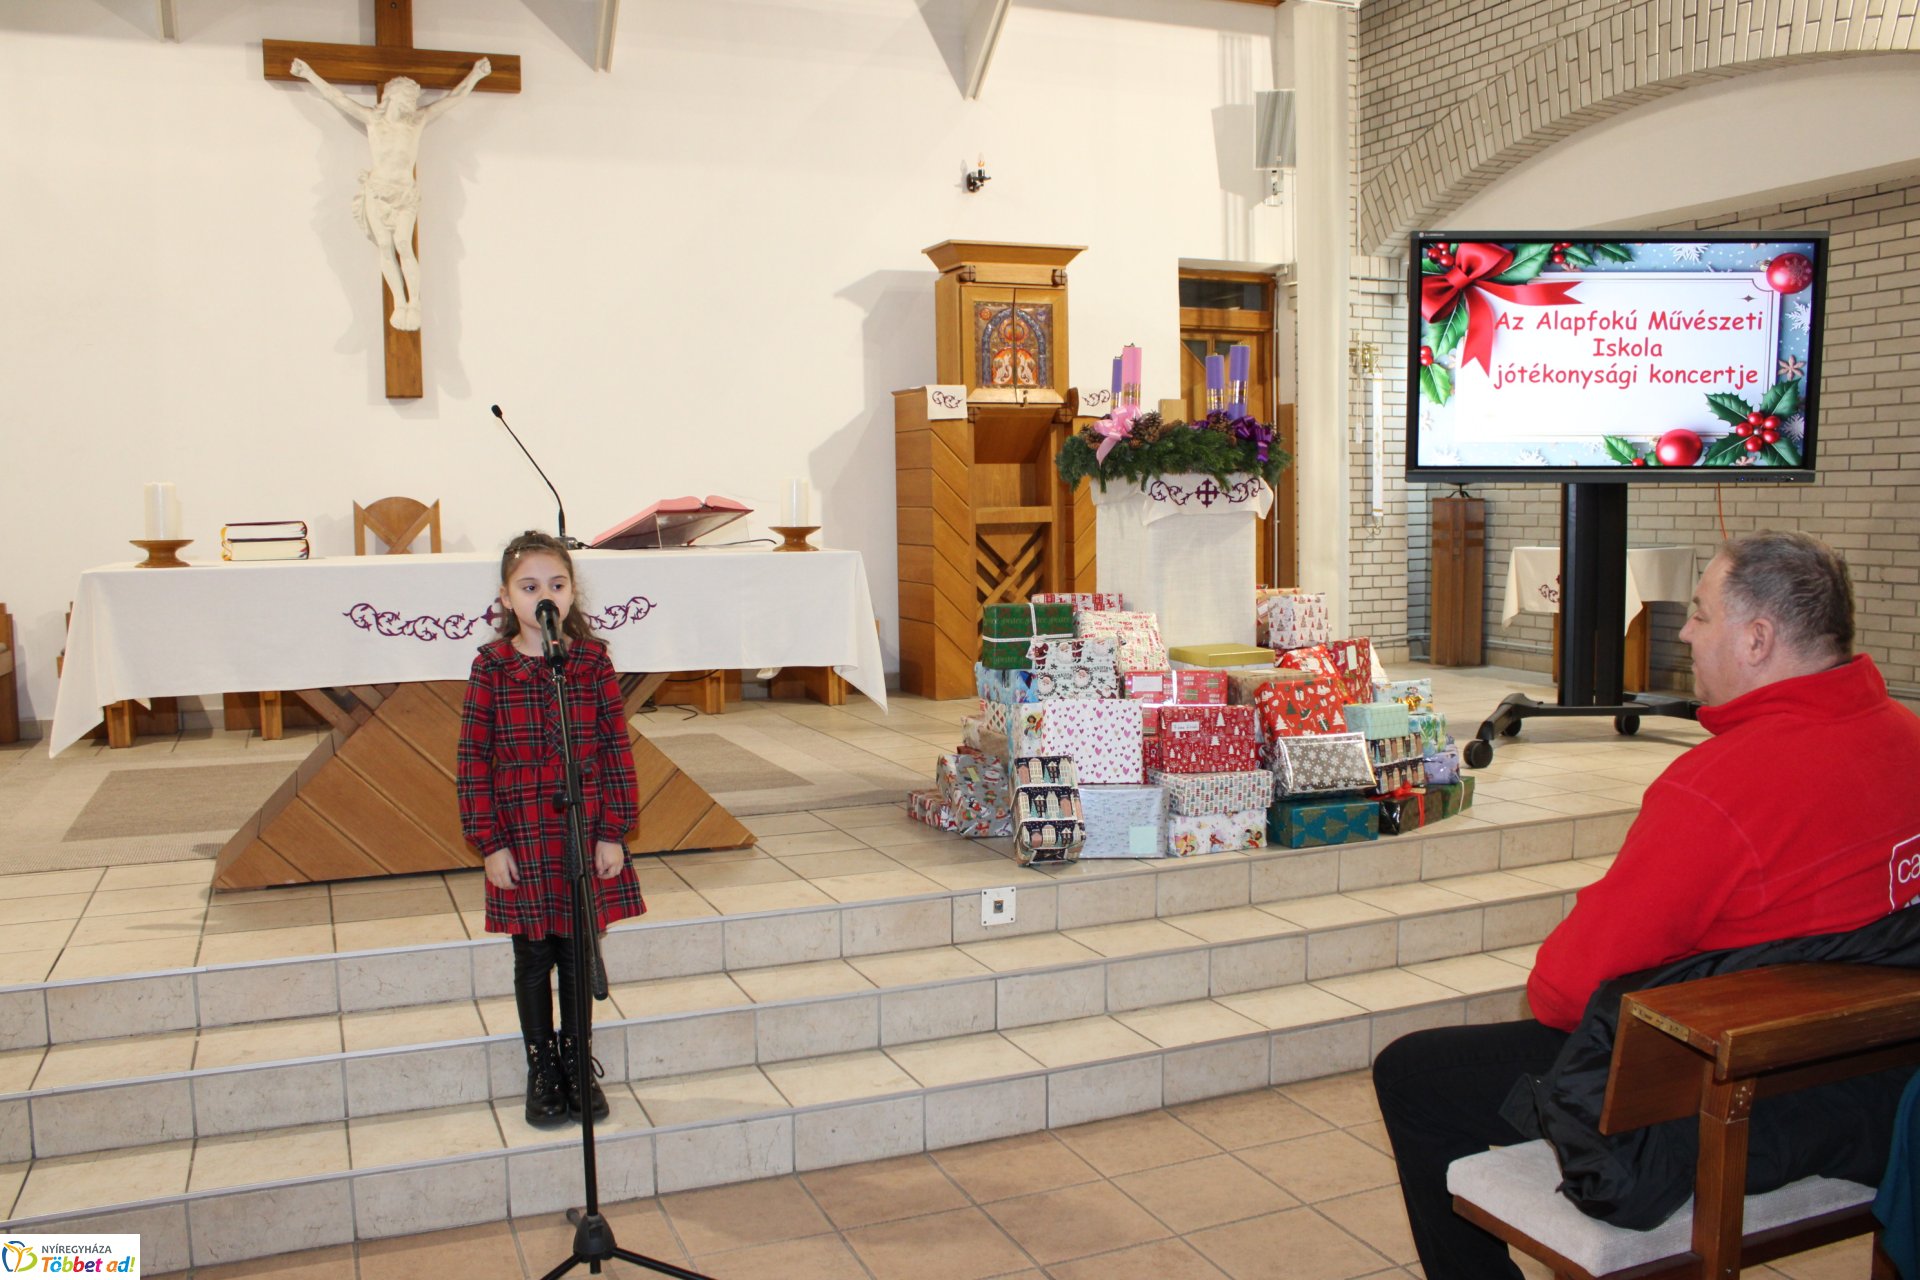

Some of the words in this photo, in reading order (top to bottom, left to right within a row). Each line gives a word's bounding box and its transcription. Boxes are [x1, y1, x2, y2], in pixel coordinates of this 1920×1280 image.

[1494, 311, 1525, 331] Az
[1536, 309, 1638, 336] Alapfokú
[1648, 309, 1763, 331] Művészeti
[1592, 336, 1663, 357] Iskola
[1493, 362, 1638, 390] jótékonysági
[1649, 363, 1759, 390] koncertje
